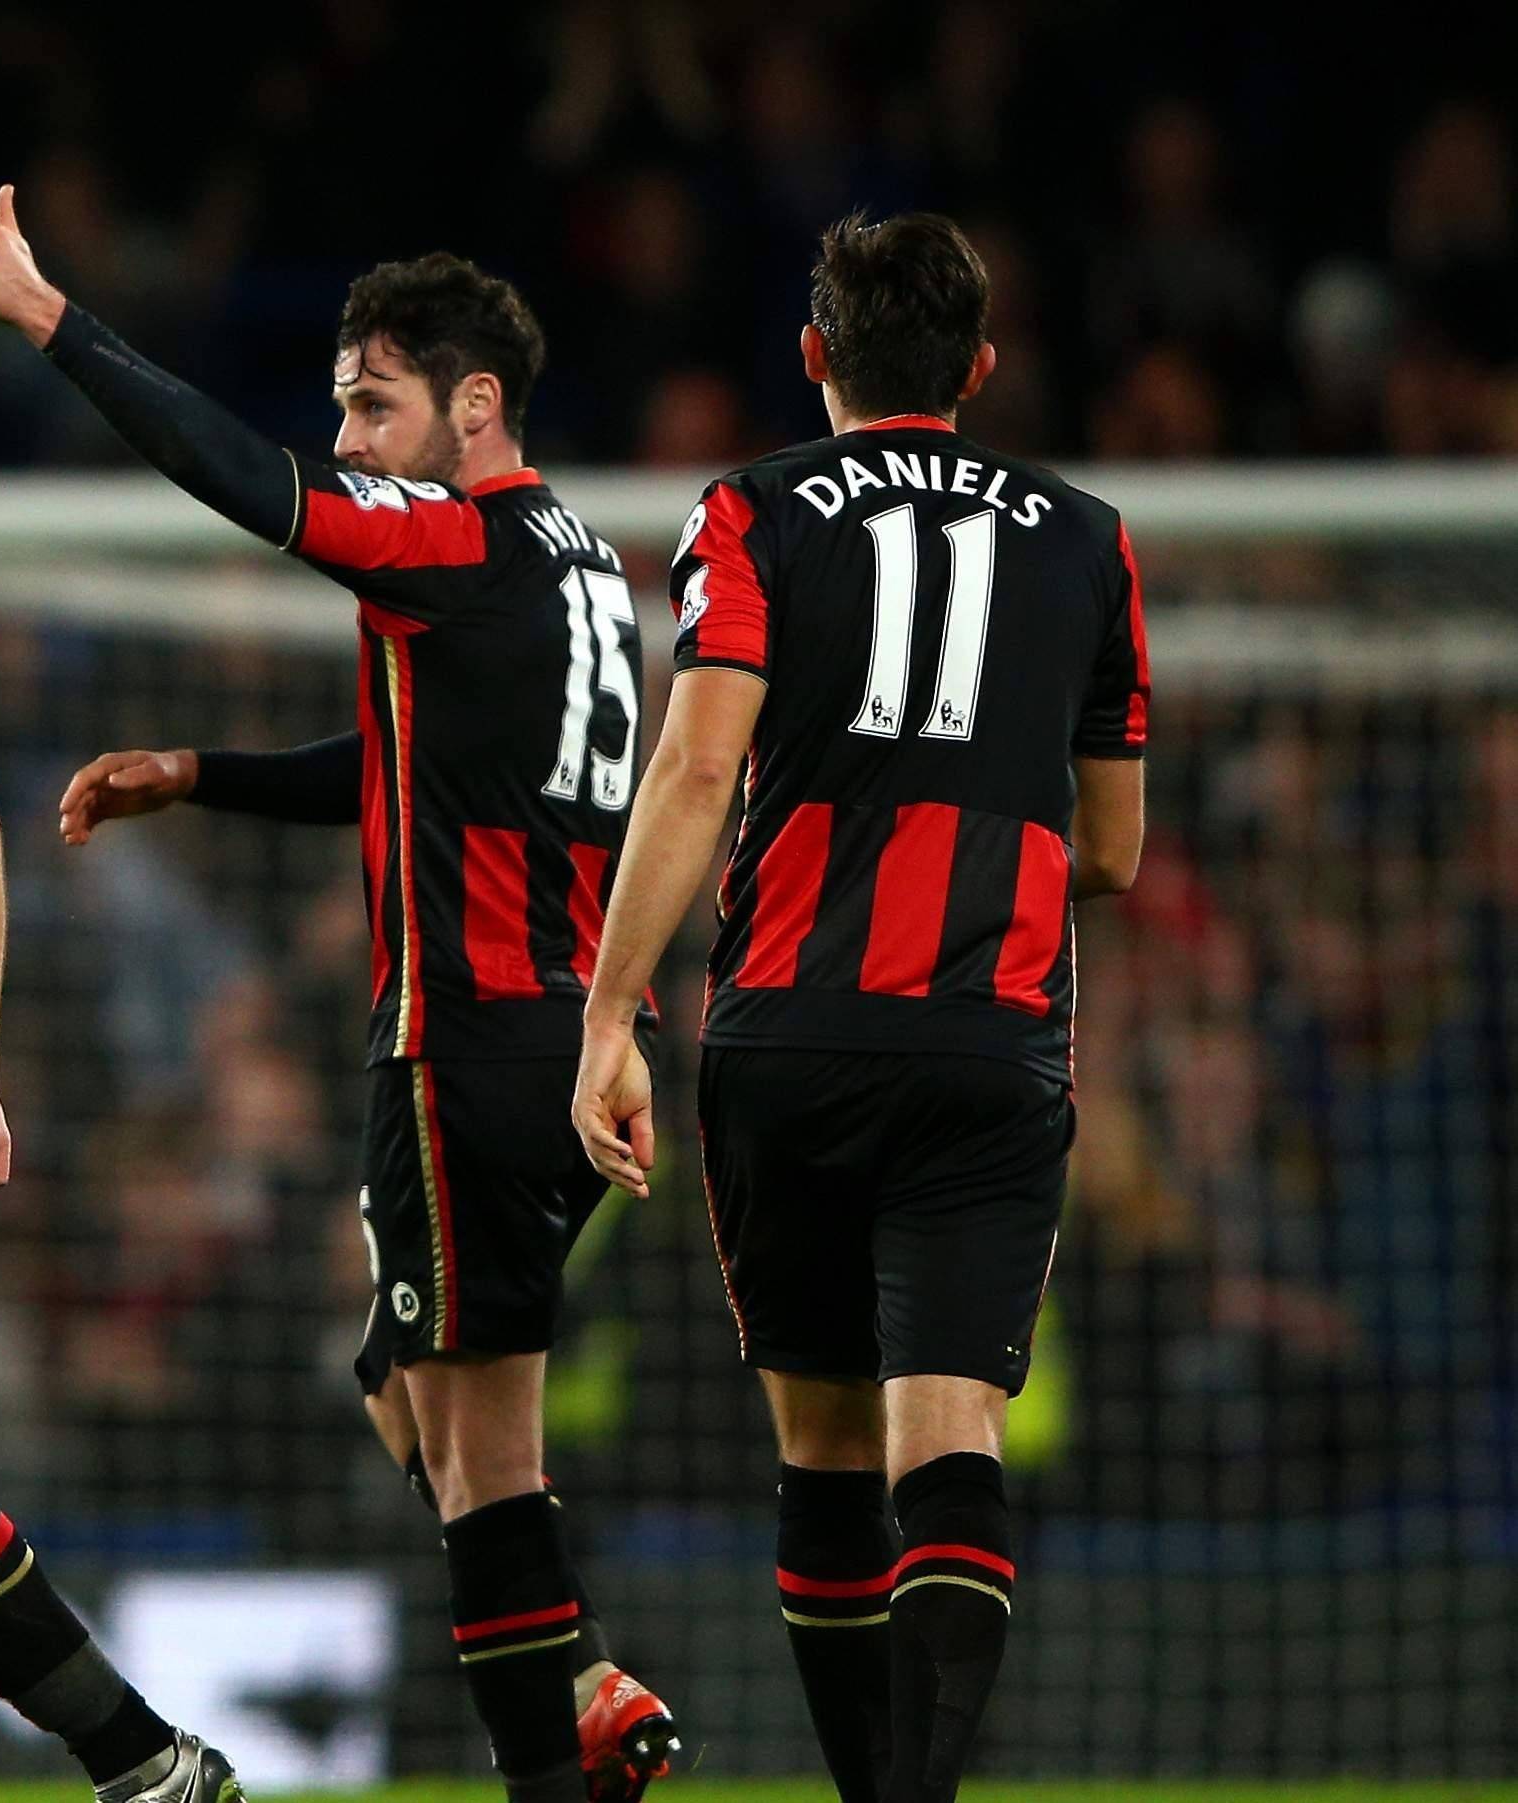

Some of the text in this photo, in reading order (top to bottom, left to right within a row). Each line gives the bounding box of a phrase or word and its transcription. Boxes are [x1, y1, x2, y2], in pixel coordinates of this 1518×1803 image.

[793, 450, 1053, 529] DANIELS
[541, 565, 640, 811] 15
[848, 502, 996, 742] 11
